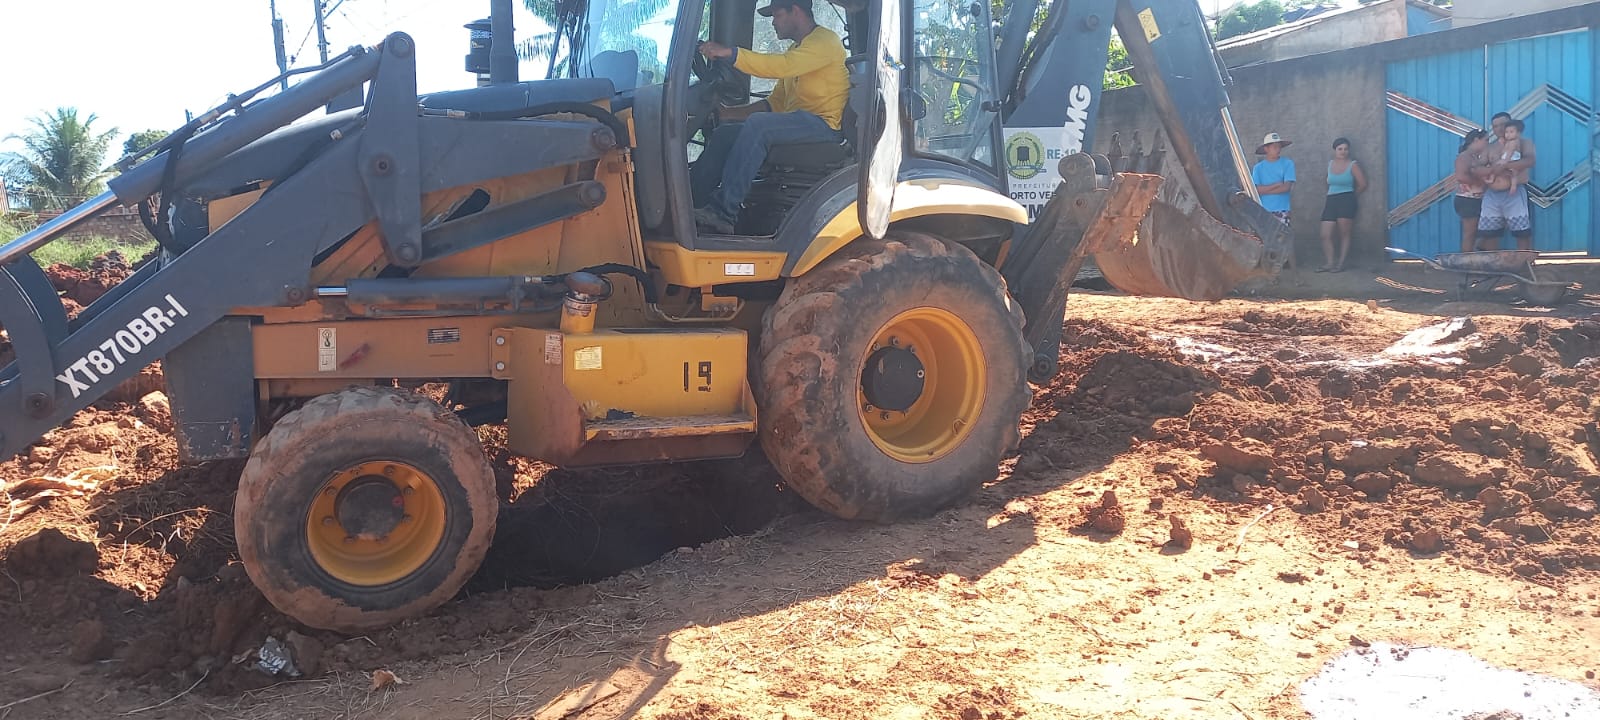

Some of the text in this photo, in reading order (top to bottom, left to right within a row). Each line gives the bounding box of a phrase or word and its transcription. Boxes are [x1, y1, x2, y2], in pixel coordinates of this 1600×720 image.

[1010, 192, 1036, 200] ORTO
[55, 293, 189, 399] XT870BR-I
[683, 361, 712, 393] 19
